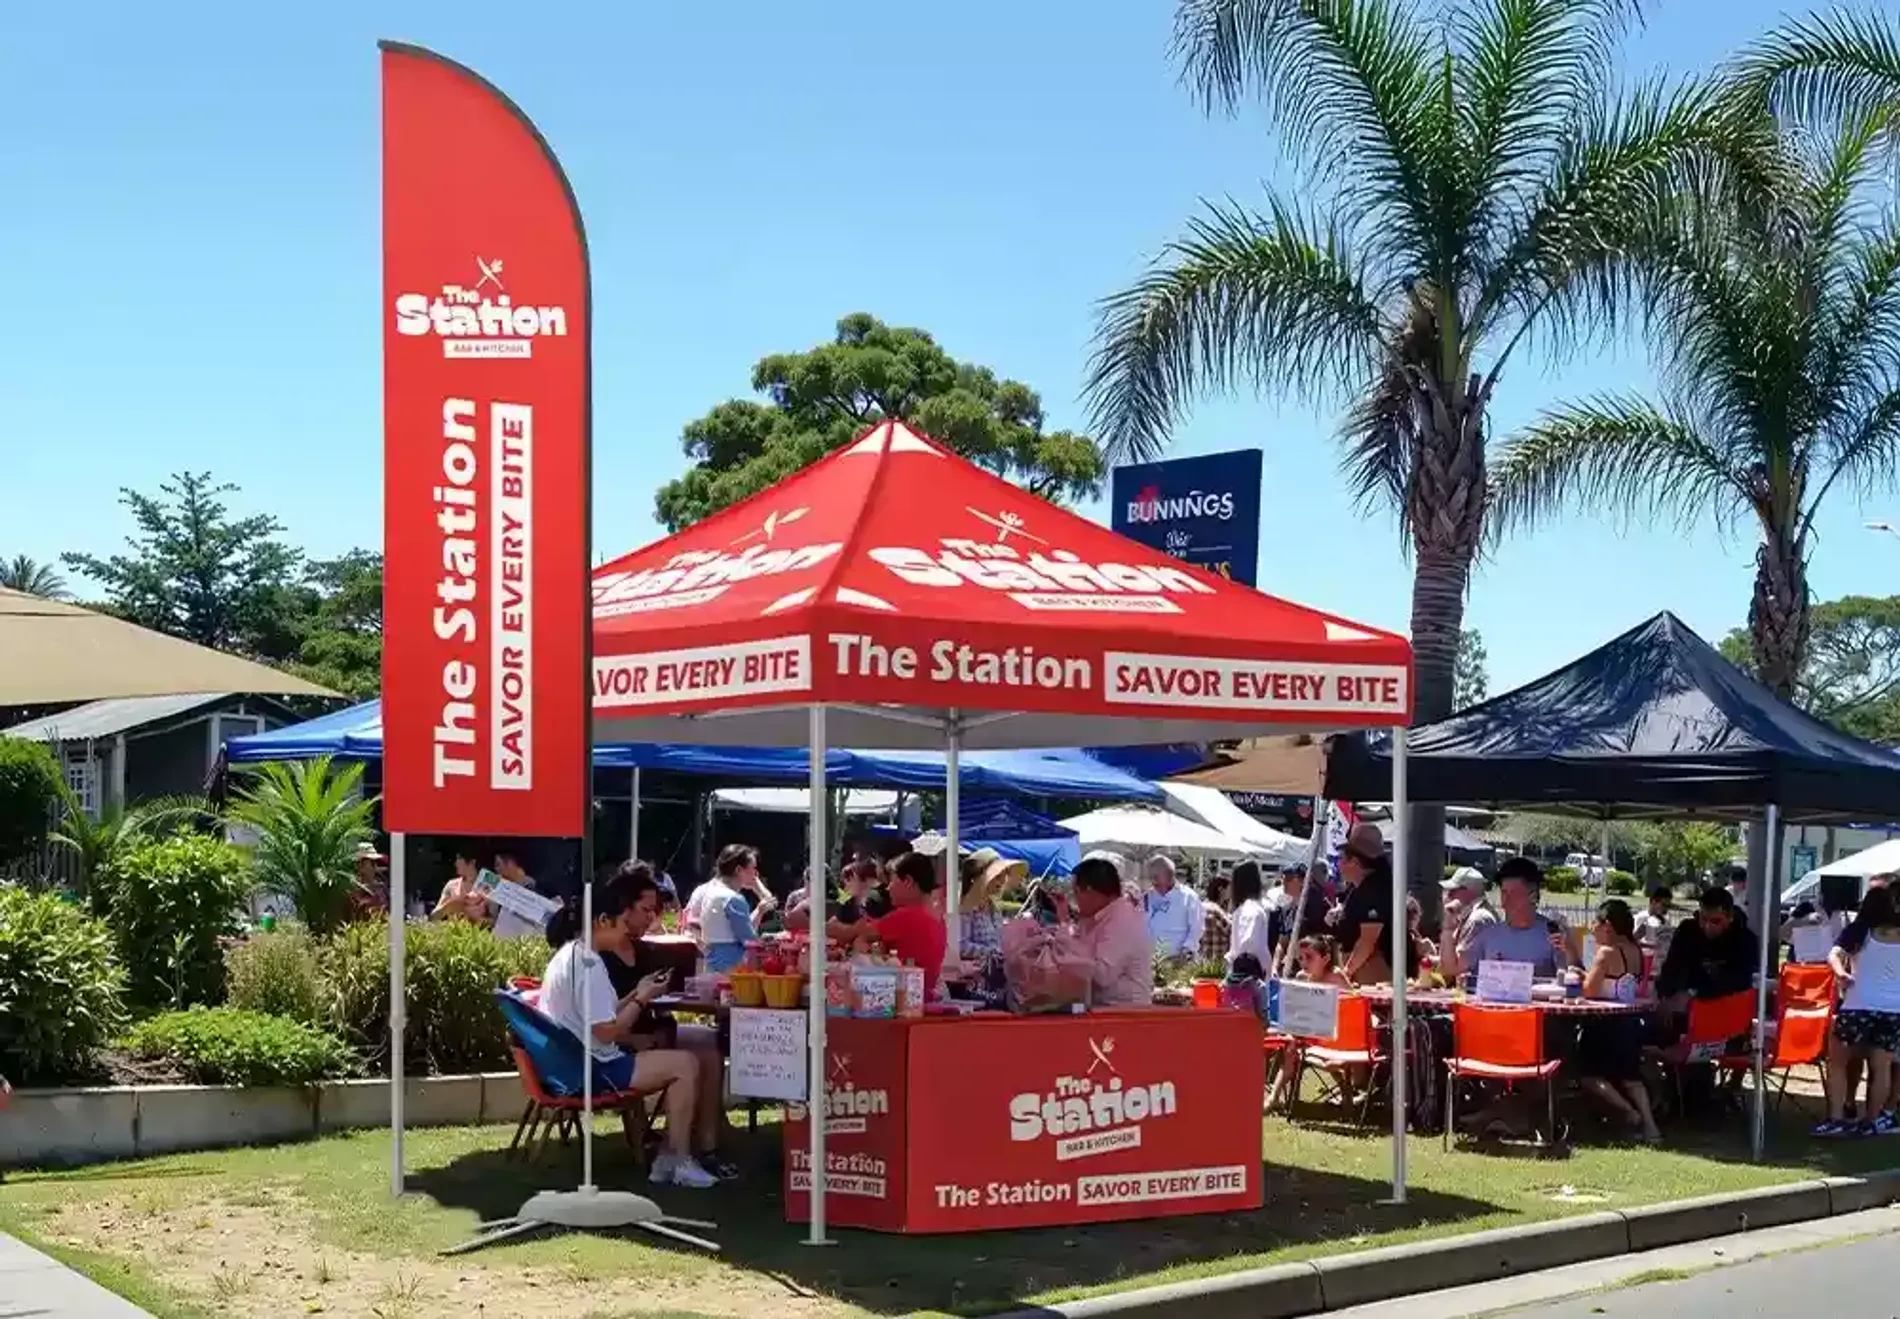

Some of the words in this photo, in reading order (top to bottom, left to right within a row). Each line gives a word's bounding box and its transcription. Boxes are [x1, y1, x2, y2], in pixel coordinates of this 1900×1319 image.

[395, 293, 567, 336] Station
[442, 285, 480, 304] The
[502, 418, 524, 499] BITE
[434, 397, 476, 643] Station
[867, 546, 1217, 594] Station
[938, 538, 1019, 559] The
[502, 512, 524, 634] EVERY
[591, 664, 648, 696] VOR
[655, 658, 736, 693] EVERY
[743, 649, 800, 685] BITE
[828, 632, 918, 678] The
[930, 639, 1092, 689] Station
[1116, 665, 1221, 698] SAVOR
[1232, 671, 1325, 700] EVERY
[1337, 676, 1399, 703] BITE
[434, 660, 476, 788] The
[502, 646, 524, 776] SAVOR
[1056, 1075, 1091, 1096] The
[1010, 1077, 1176, 1141] Station
[790, 1149, 813, 1168] Th
[826, 1152, 886, 1175] tation
[825, 1178, 859, 1190] VERY
[934, 1185, 979, 1207] The
[986, 1180, 1071, 1207] Station
[1082, 1180, 1141, 1200] SAVOR
[1148, 1176, 1200, 1194] EVERY
[1205, 1172, 1241, 1191] BITE
